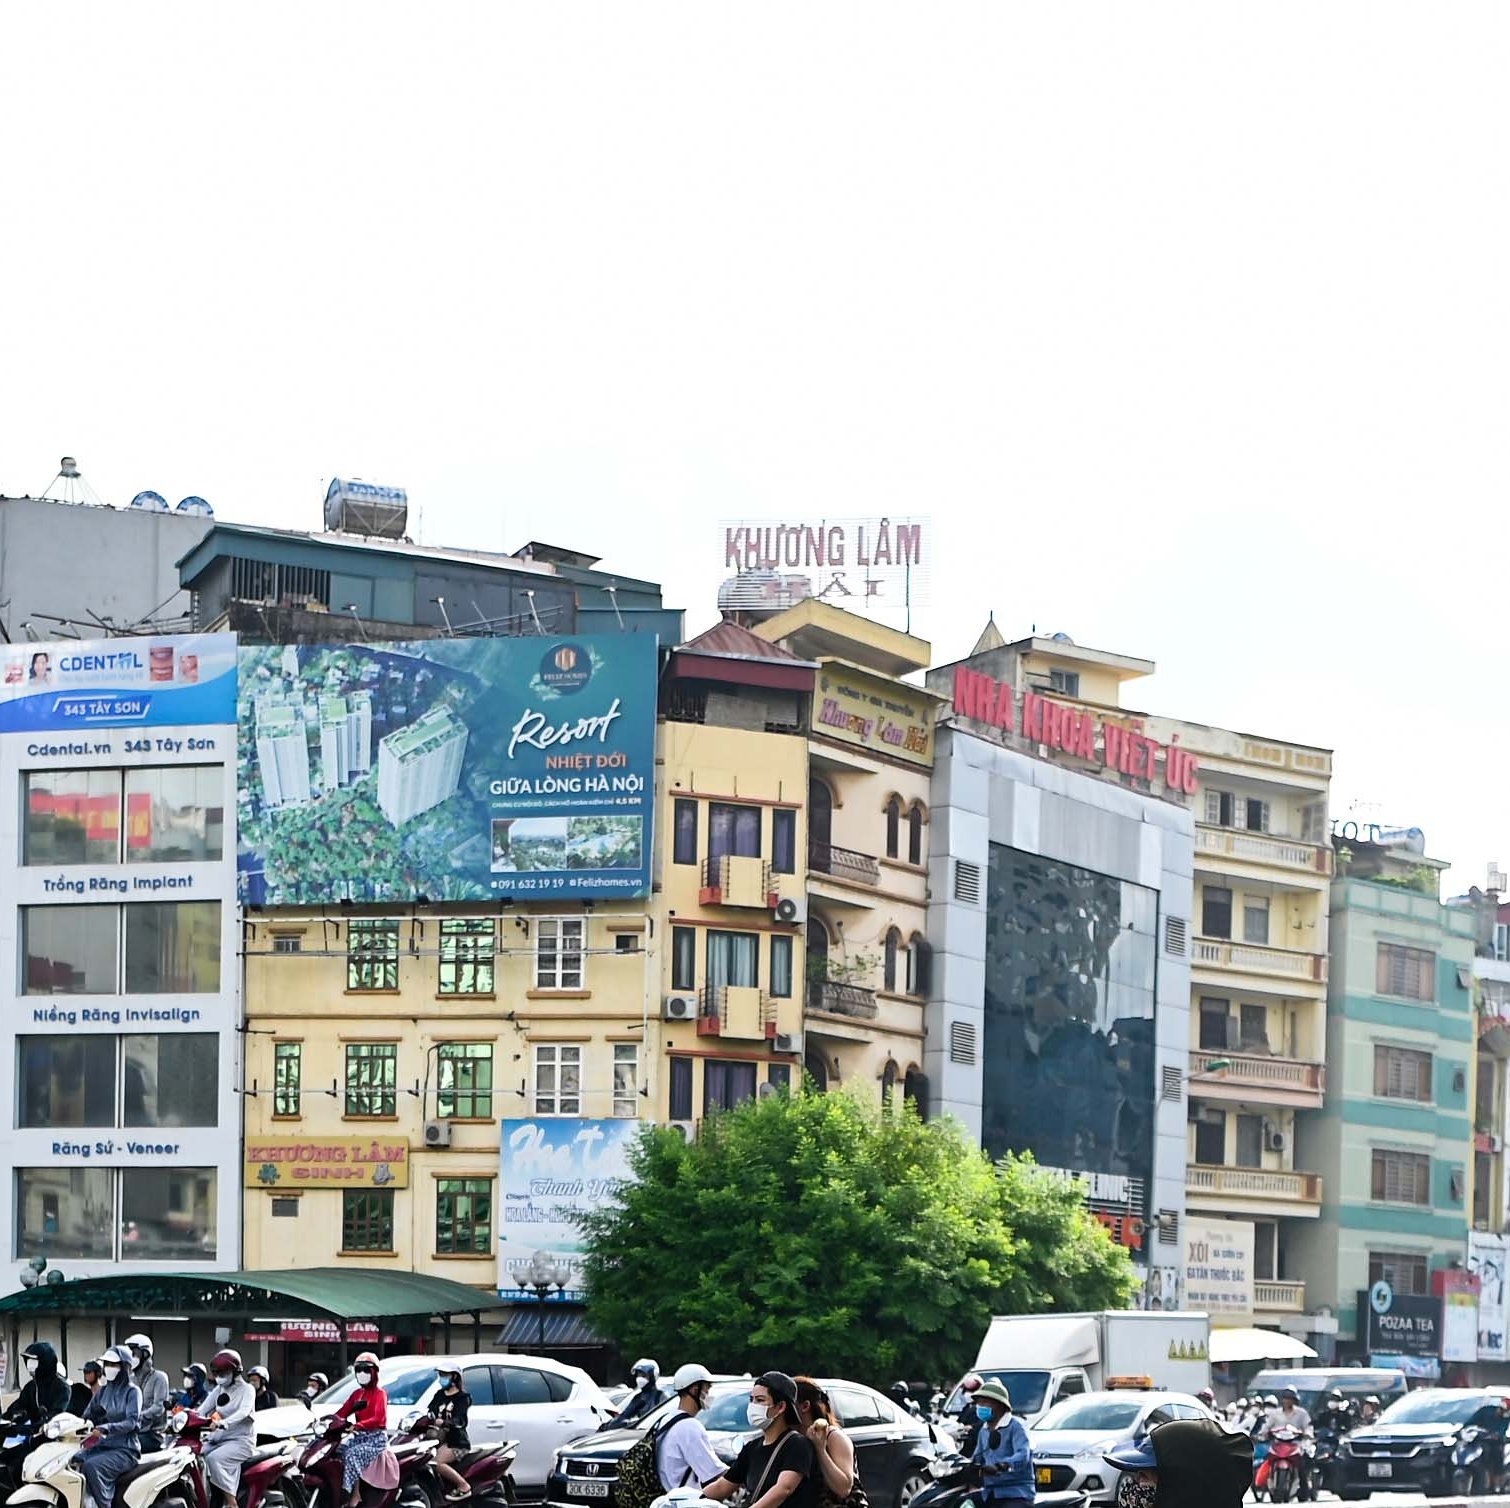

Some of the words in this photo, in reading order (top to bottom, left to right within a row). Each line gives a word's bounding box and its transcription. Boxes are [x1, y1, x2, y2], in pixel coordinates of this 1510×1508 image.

[725, 523, 845, 568] KHƯƠNG
[64, 703, 86, 716] 343
[89, 700, 111, 715] TÂY
[114, 701, 140, 714] SƠN
[507, 698, 622, 760] Resort
[953, 664, 1014, 732] NHA
[1022, 691, 1095, 761] KHOA
[1102, 720, 1160, 791] VIỆT
[1164, 733, 1200, 796] ÚC
[27, 742, 112, 757] Cdental.vn
[124, 739, 151, 753] 343
[156, 738, 182, 755] Tây
[187, 737, 216, 751] Sơn
[545, 752, 594, 771] NHIỆT
[596, 751, 627, 768] ĐỚI
[490, 777, 532, 795] GIỮA
[535, 775, 582, 794] LÒNG
[585, 773, 610, 792] HÀ
[613, 773, 644, 794] NỘI
[627, 797, 642, 805] KM
[43, 873, 85, 894] Trồng
[90, 875, 128, 893] Răng
[133, 875, 193, 893] Implant
[498, 880, 515, 890] 091
[518, 879, 536, 889] 632
[539, 879, 549, 888] 19
[553, 878, 564, 888] 19
[577, 877, 643, 888] Felizhomes.vn
[81, 1007, 120, 1024] Răng
[125, 1007, 201, 1024] Invisalign
[52, 1142, 91, 1158] Răng
[95, 1140, 114, 1155] Sứ
[126, 1142, 180, 1155] Veneer
[247, 1143, 348, 1162] KHƯƠNG
[351, 1140, 405, 1162] LÂM
[292, 1168, 364, 1179] SINH
[530, 1177, 585, 1198] Thanh
[1379, 1315, 1413, 1330] POZAA
[1416, 1318, 1434, 1332] TEA
